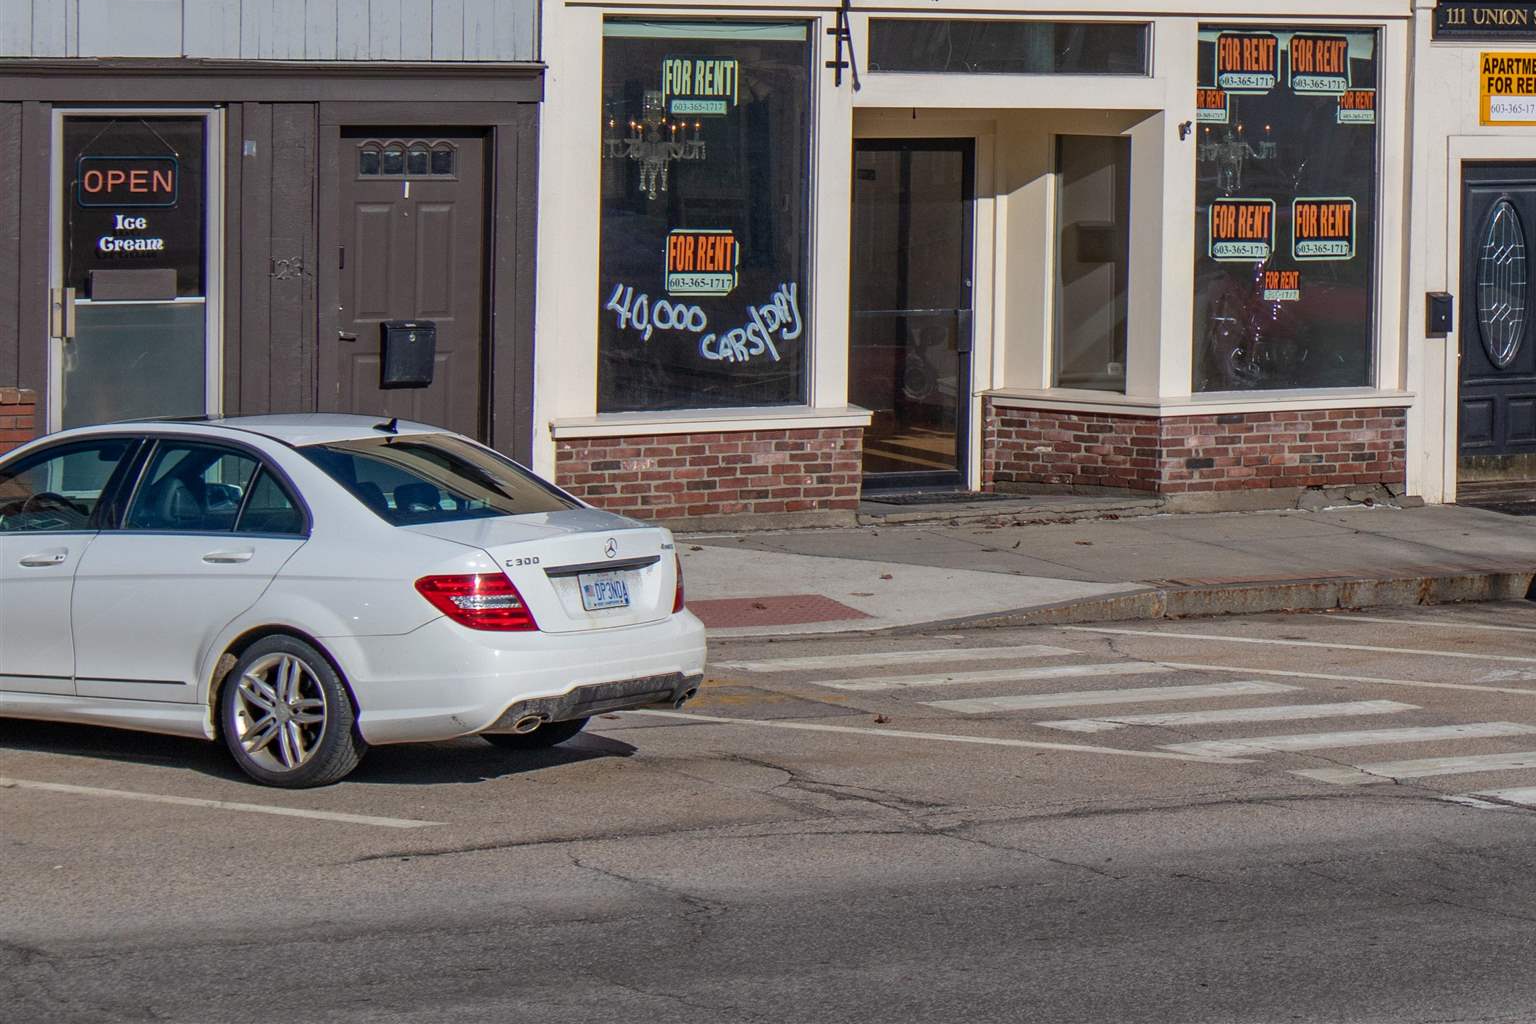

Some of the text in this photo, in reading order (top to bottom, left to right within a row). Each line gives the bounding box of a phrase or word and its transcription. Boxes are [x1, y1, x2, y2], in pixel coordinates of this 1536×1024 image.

[1446, 8, 1467, 24] 111
[1472, 8, 1528, 25] UNION
[1219, 38, 1276, 72] FOR RENT
[1292, 39, 1346, 73] FOR RENT
[666, 59, 735, 96] FOR RENT
[1220, 76, 1275, 87] 603-365-1717
[1293, 78, 1346, 89] 603-365-1717
[1487, 77, 1513, 94] FOR
[673, 103, 723, 112] 603-365-1717
[1355, 92, 1374, 109] RENT
[84, 170, 173, 193] OPEN
[115, 214, 147, 230] Ice
[1213, 205, 1271, 239] FOR RENT
[1296, 204, 1350, 237] FOR RENT
[99, 236, 165, 251] Cream
[1213, 244, 1270, 255] 603-365-1717
[1296, 243, 1350, 254] 603-365-1717
[669, 235, 735, 272] FOR RENT
[669, 278, 732, 289] 603-365-1717
[1265, 271, 1299, 289] FOR RENT
[606, 282, 707, 341] 40,000
[506, 556, 540, 567] C 300
